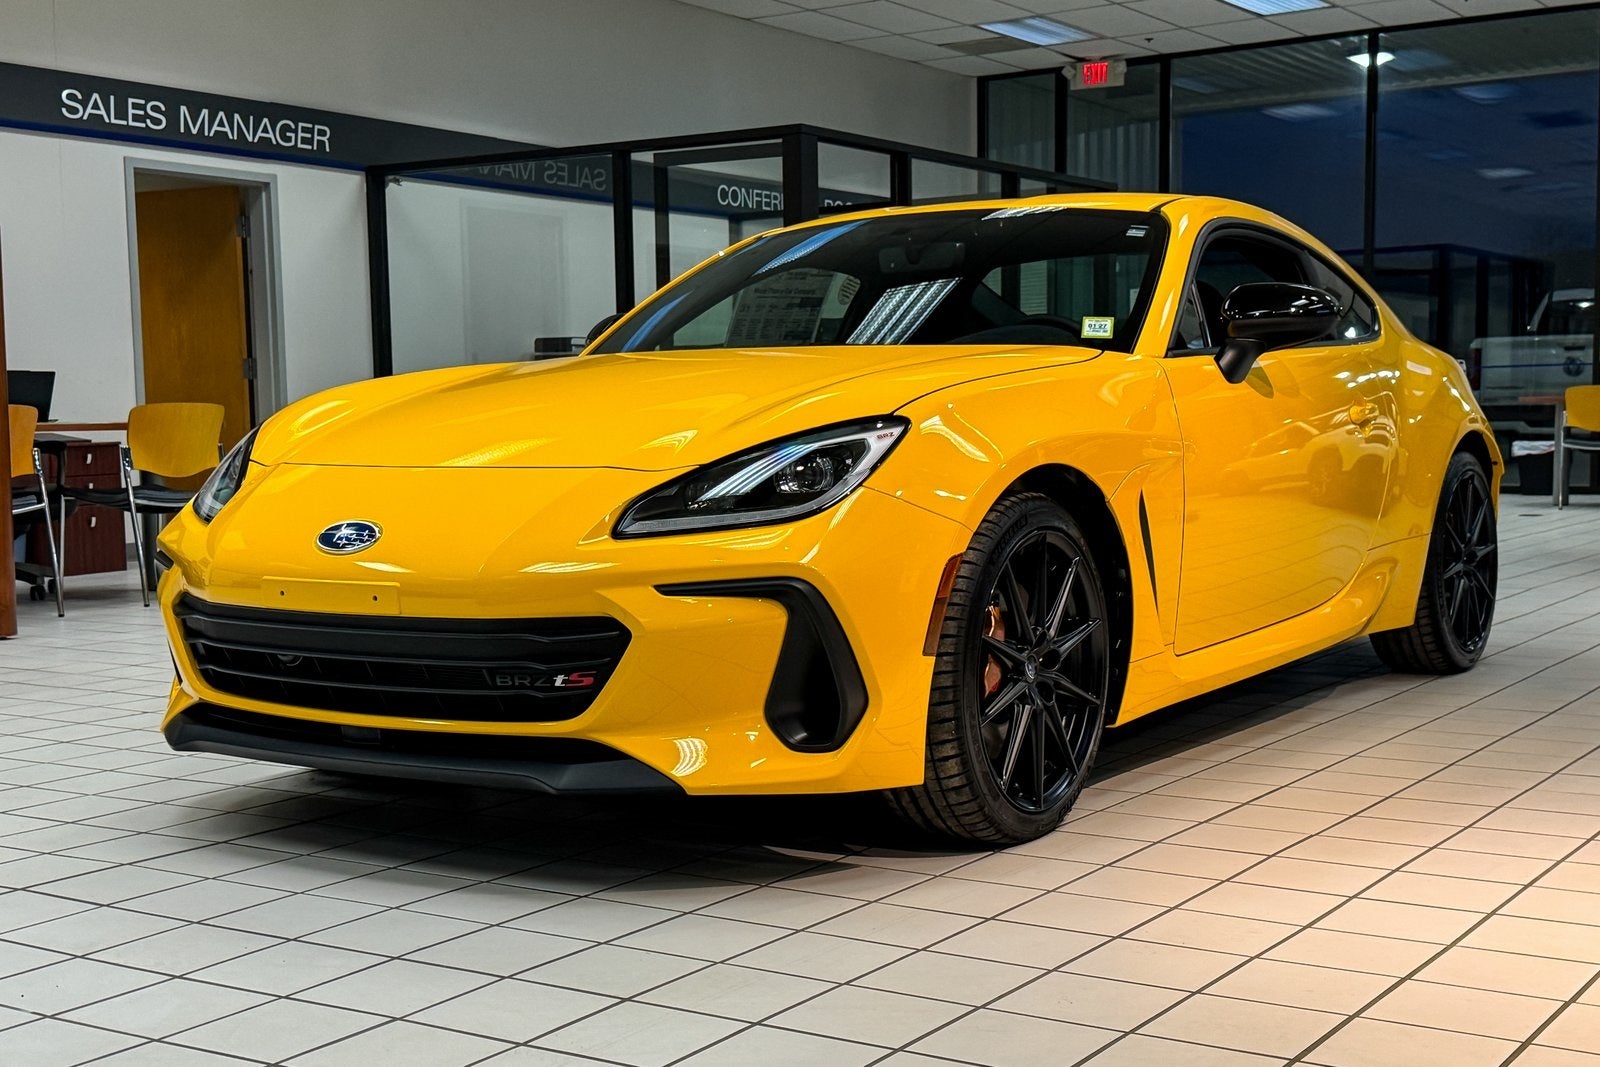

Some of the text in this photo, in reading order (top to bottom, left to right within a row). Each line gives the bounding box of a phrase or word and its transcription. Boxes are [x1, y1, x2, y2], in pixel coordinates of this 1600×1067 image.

[1083, 62, 1108, 85] EXIT
[61, 88, 331, 152] SALES MANAGER
[717, 184, 784, 211] CONFER
[495, 674, 552, 687] BRZ
